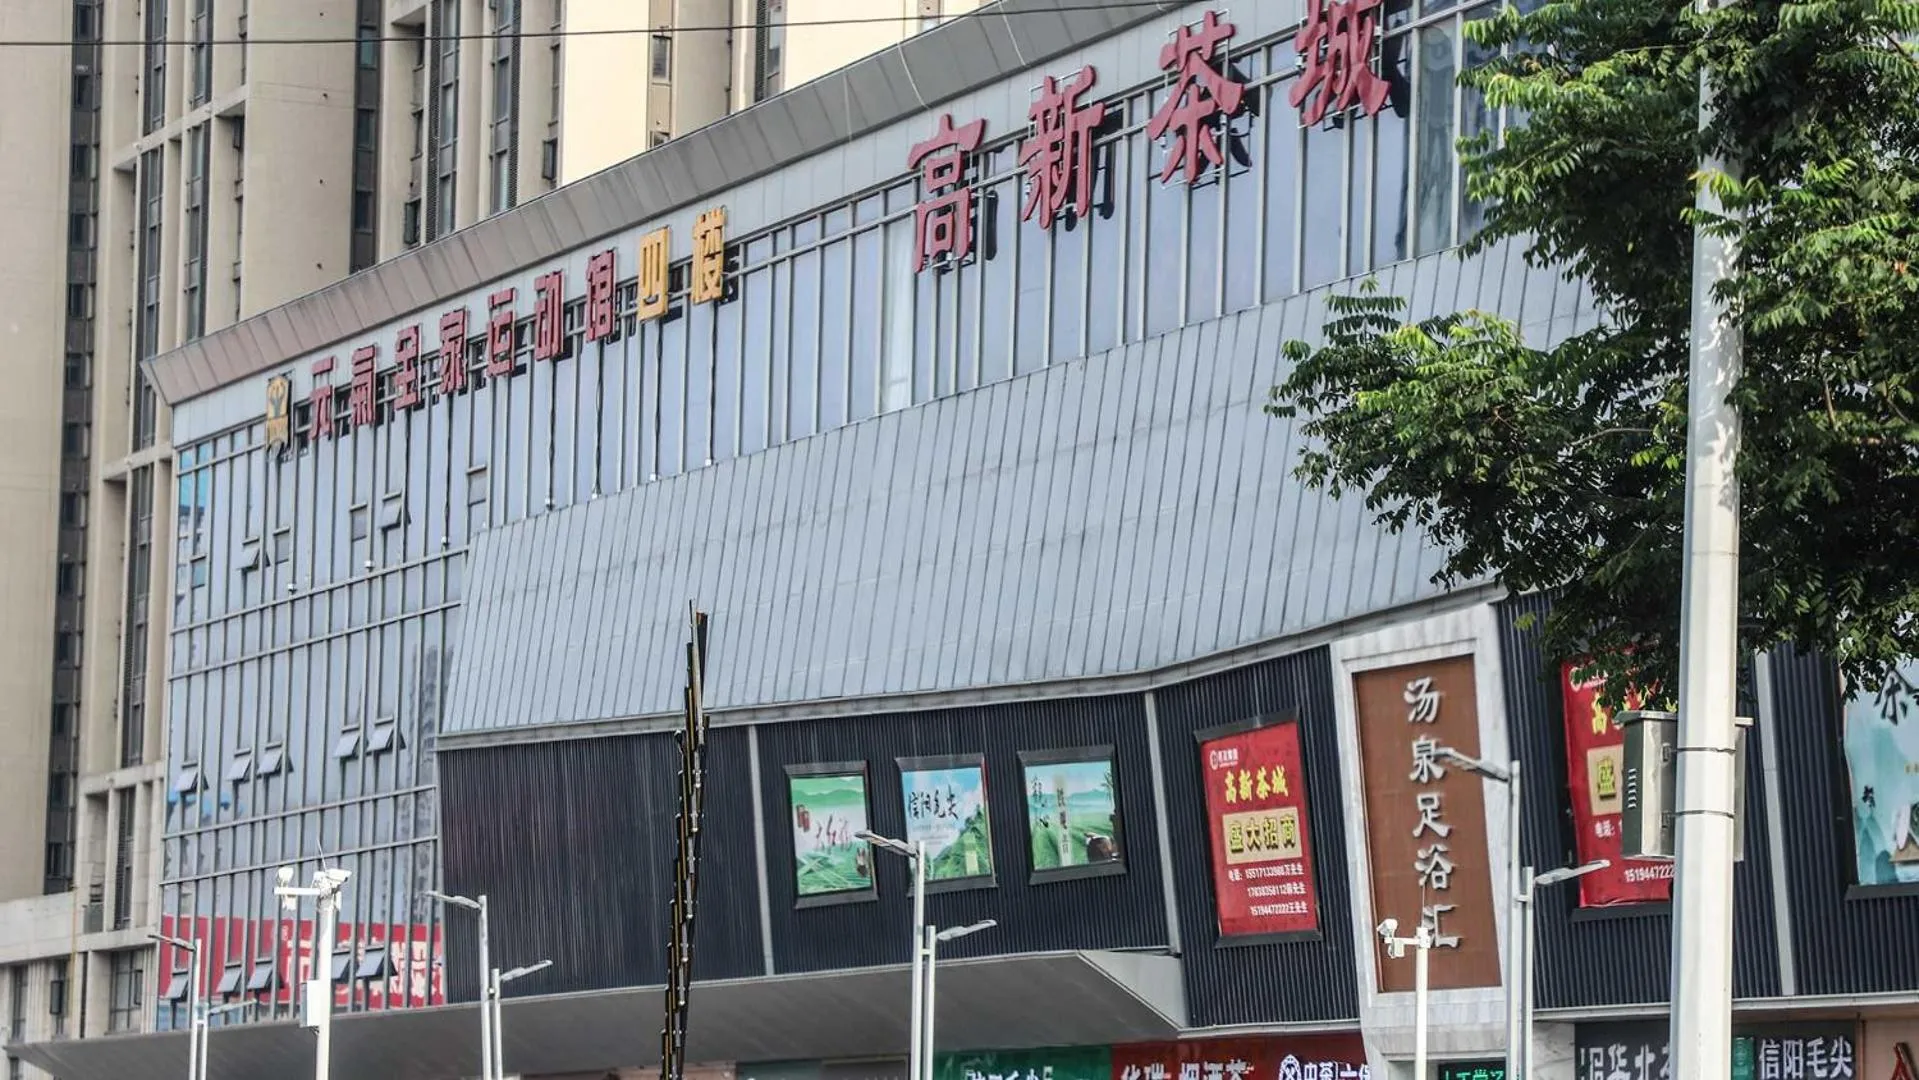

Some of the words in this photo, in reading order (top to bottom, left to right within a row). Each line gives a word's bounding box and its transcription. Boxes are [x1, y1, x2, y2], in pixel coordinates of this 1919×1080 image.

[907, 0, 1392, 273] 高新茶城
[1224, 765, 1289, 804] 高新茶城
[1228, 815, 1297, 854] 盛大招商
[1403, 676, 1463, 949] 汤泉足浴汇
[1758, 1035, 1854, 1080] 信阳毛尖
